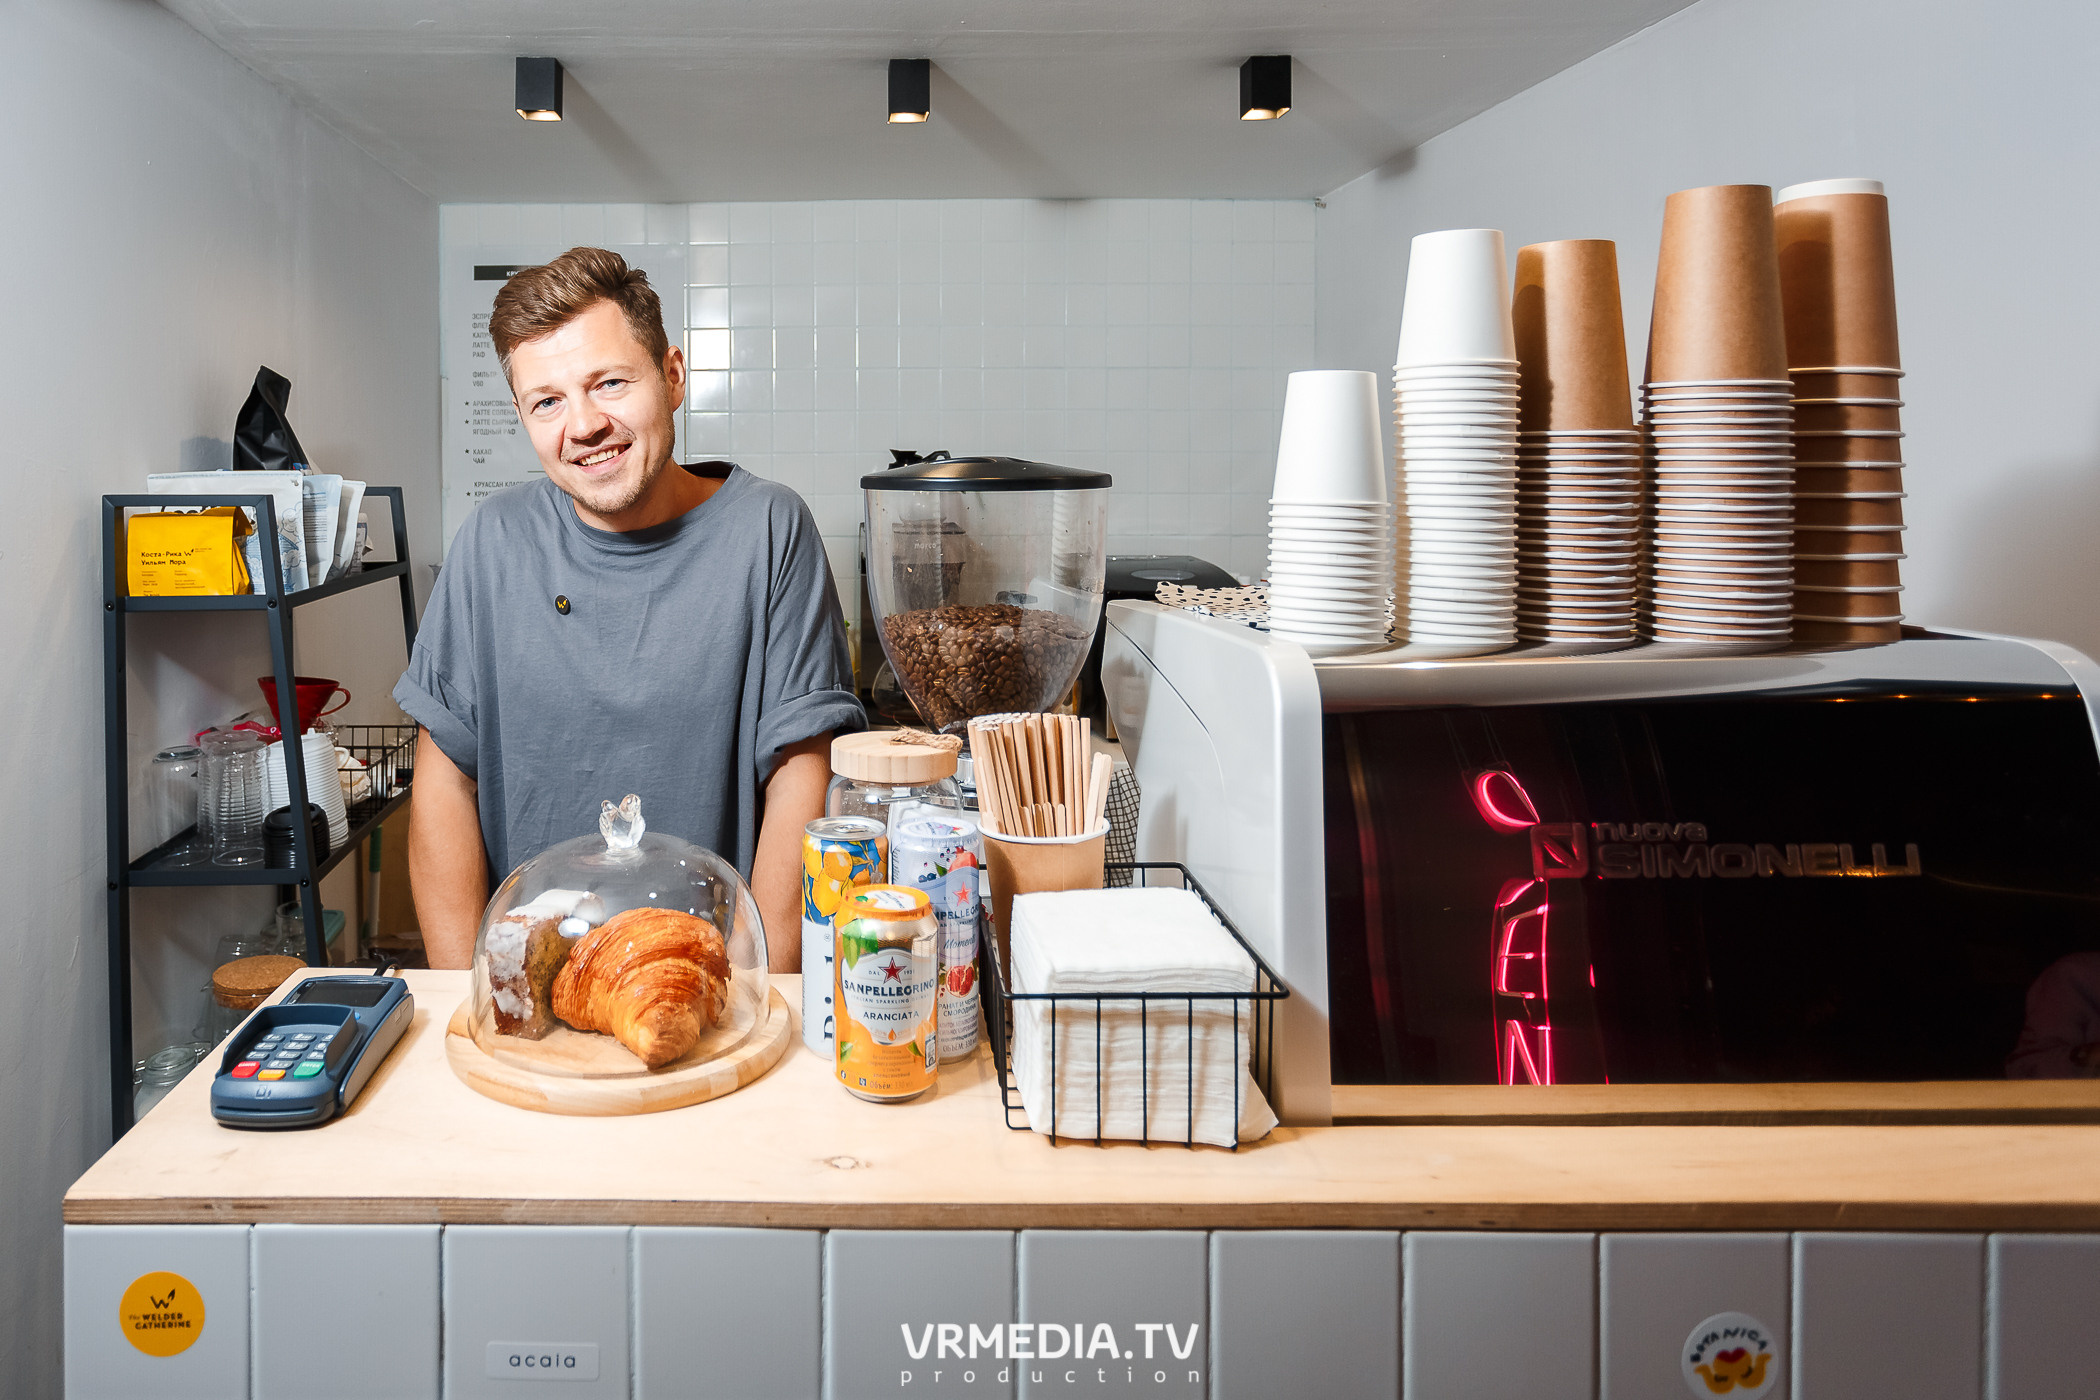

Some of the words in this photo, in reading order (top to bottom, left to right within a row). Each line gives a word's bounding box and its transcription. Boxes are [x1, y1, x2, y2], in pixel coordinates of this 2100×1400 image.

[472, 456, 485, 464] ЧАЙ
[1595, 820, 1708, 843] nuova
[1596, 841, 1922, 880] SIMONELLI
[844, 978, 935, 997] SANPELLEGRINO
[863, 1010, 920, 1021] ARANCIATA
[142, 1312, 183, 1321] WELDER
[134, 1320, 191, 1330] CATHERINE
[509, 1353, 576, 1368] acaia
